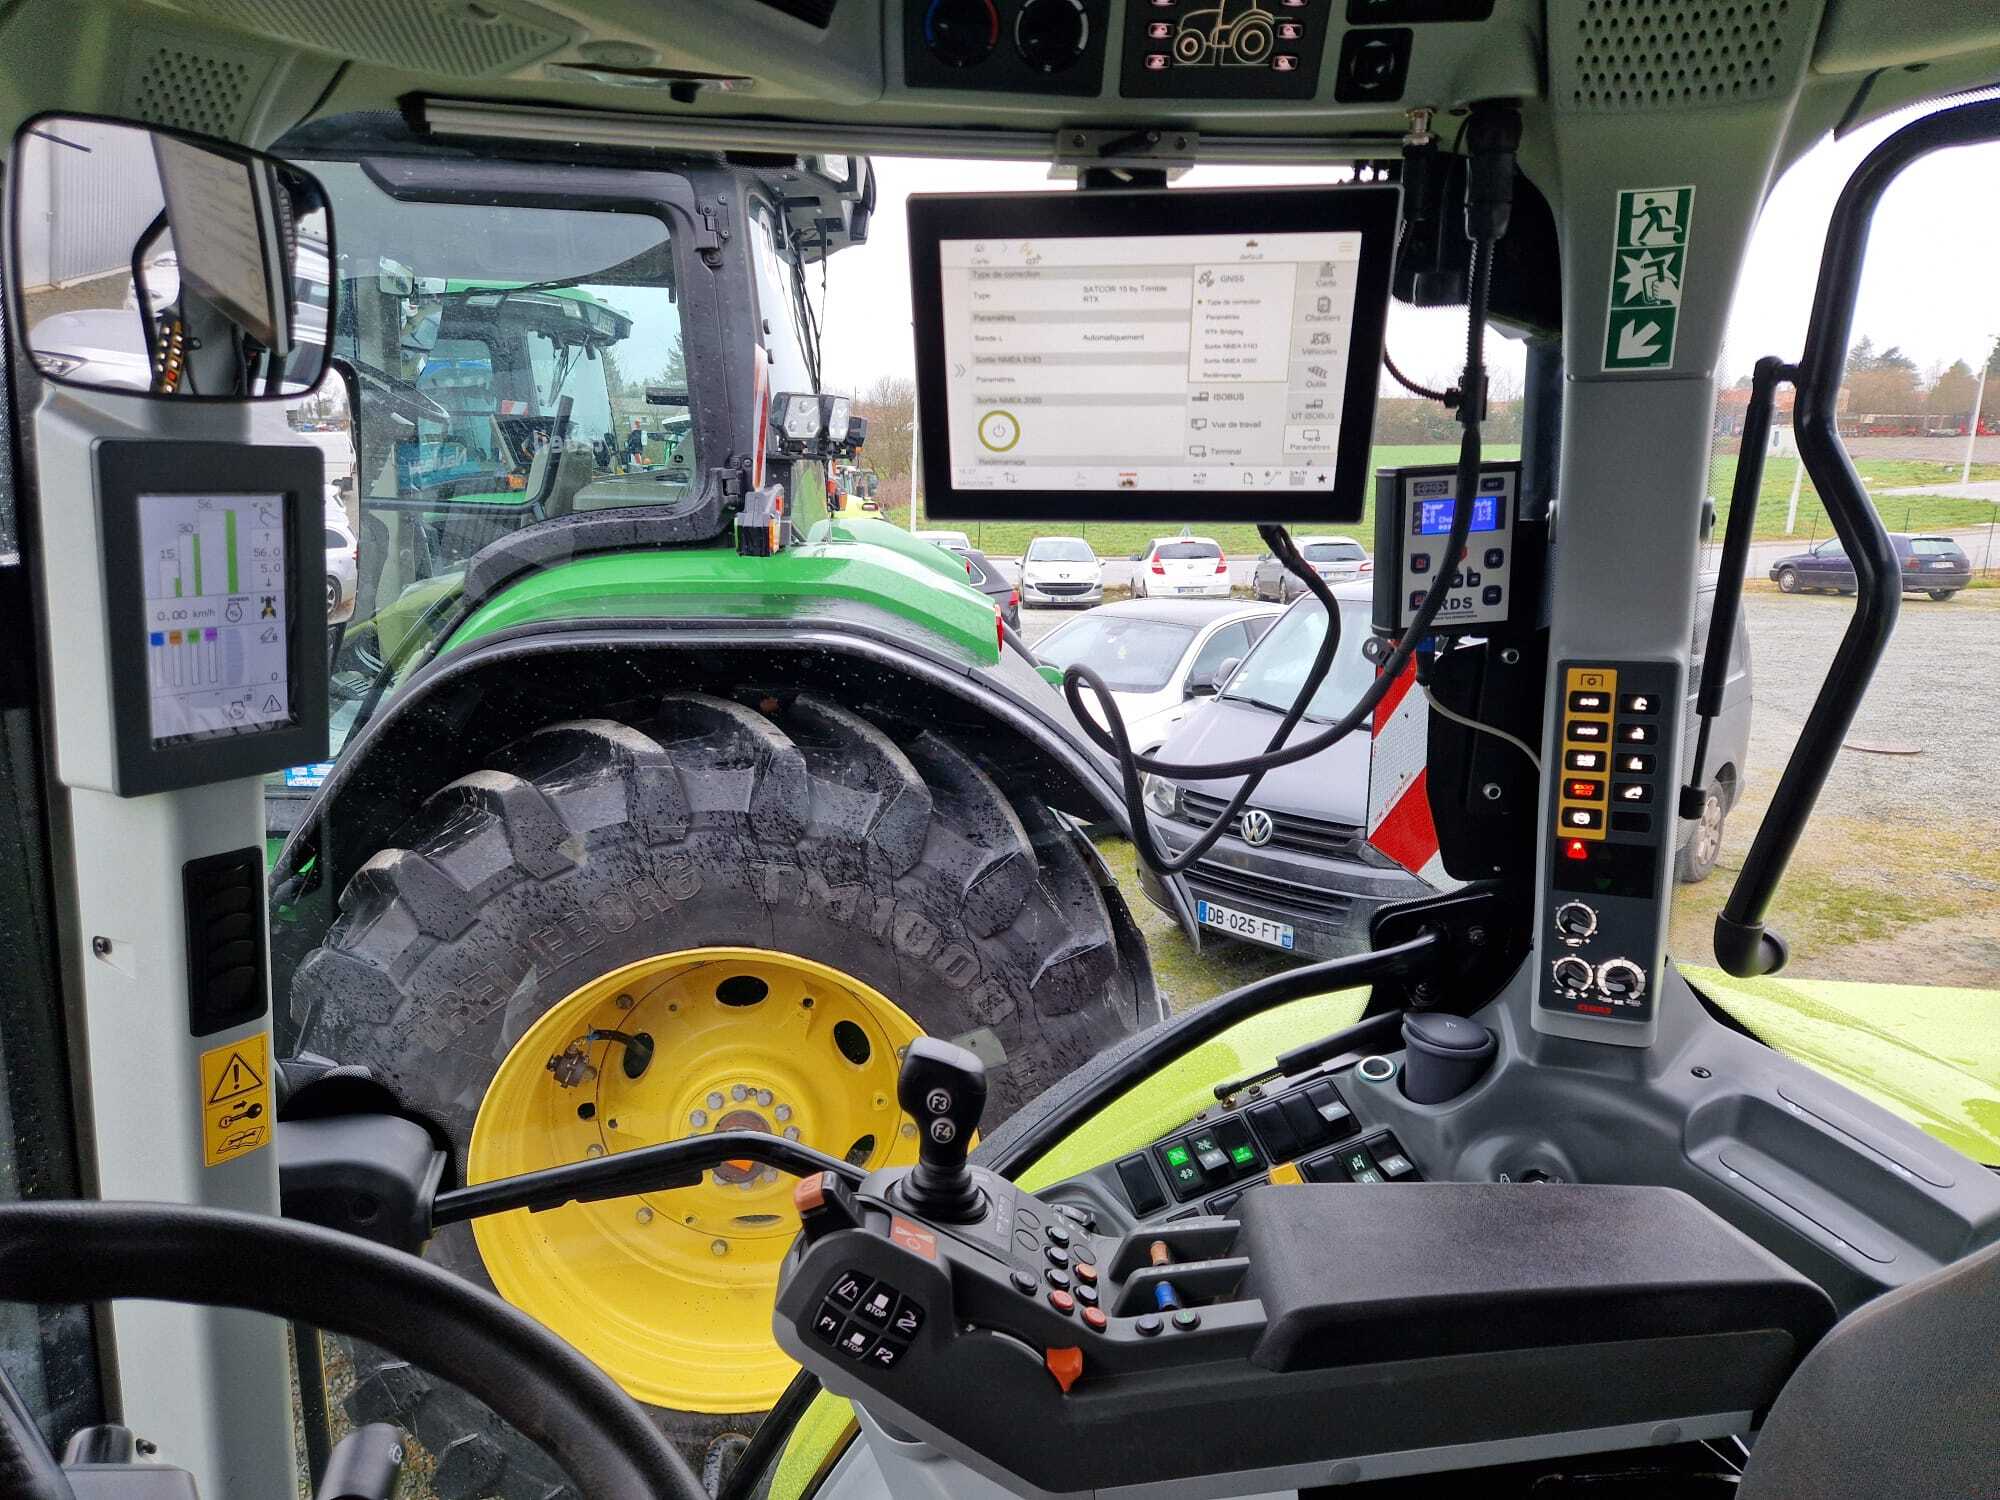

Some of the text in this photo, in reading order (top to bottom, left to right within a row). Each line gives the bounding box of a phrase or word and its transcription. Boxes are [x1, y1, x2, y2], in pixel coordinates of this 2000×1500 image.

[1220, 274, 1246, 283] GNSS
[1082, 333, 1145, 343] Automatiquement
[1213, 393, 1245, 401] ISOBUS
[1211, 420, 1262, 429] Vue de travail
[179, 523, 194, 534] 30
[160, 548, 175, 560] 15
[253, 547, 281, 558] 56.0
[260, 563, 281, 574] 5.0
[192, 607, 216, 619] km/h
[932, 1095, 948, 1110] F3
[935, 1124, 952, 1139] F4
[864, 1302, 887, 1317] STOP
[820, 1315, 837, 1331] F1
[842, 1338, 863, 1353] STOP
[875, 1347, 894, 1364] F2
